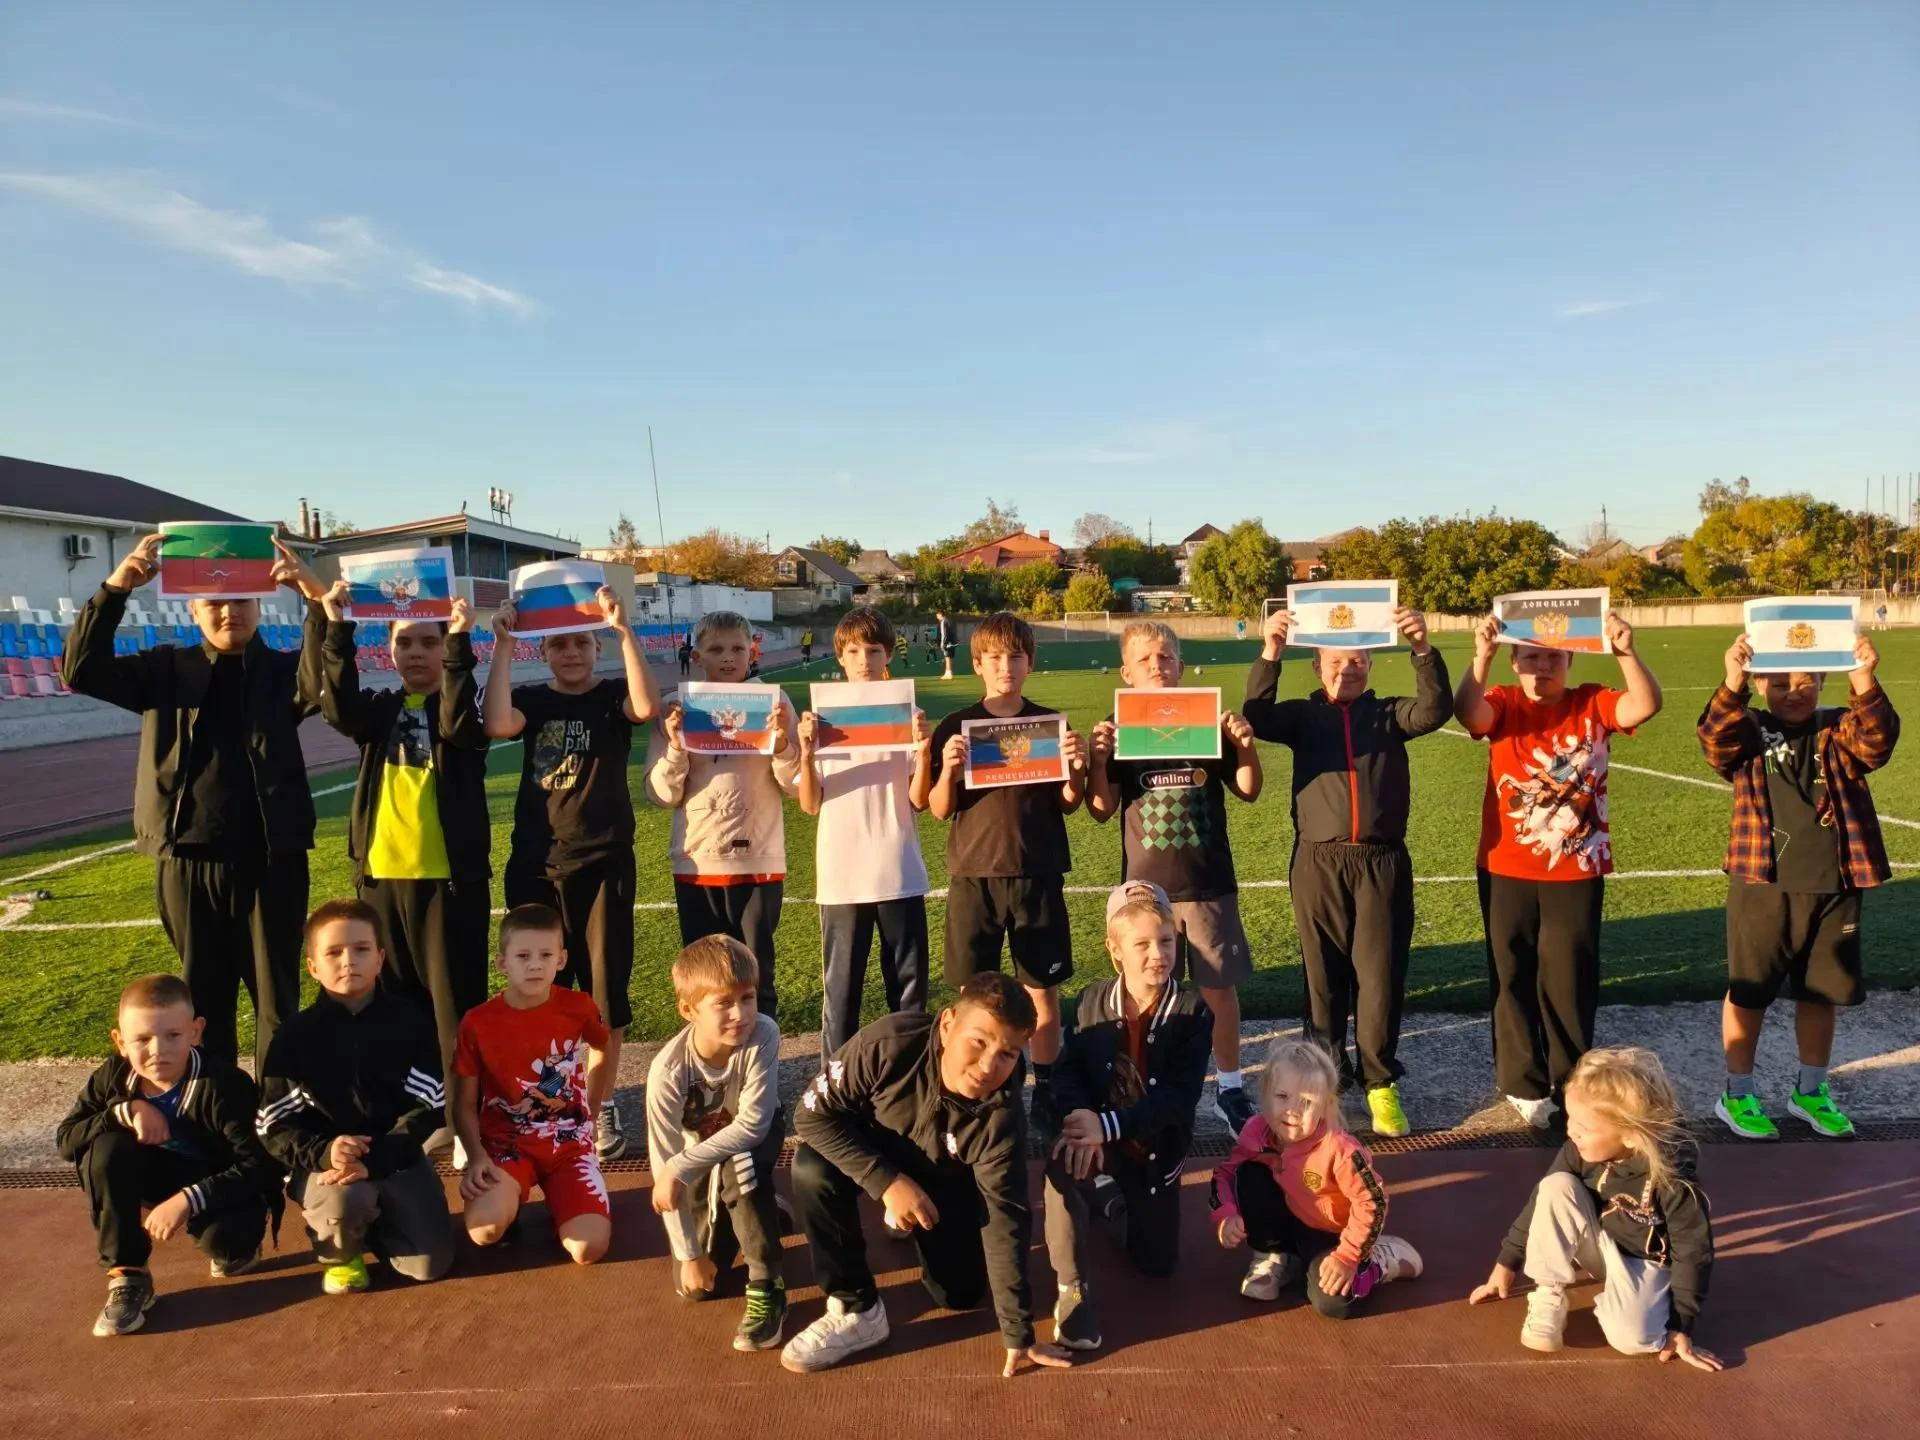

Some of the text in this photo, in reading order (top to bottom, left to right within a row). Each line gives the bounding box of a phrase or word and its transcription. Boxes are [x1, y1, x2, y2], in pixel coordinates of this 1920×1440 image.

[1521, 599, 1580, 609] ДОНЕЦКАЯ
[567, 720, 584, 736] NO
[987, 723, 1040, 734] ДОНЕЦКАЯ
[1146, 773, 1191, 785] Winline
